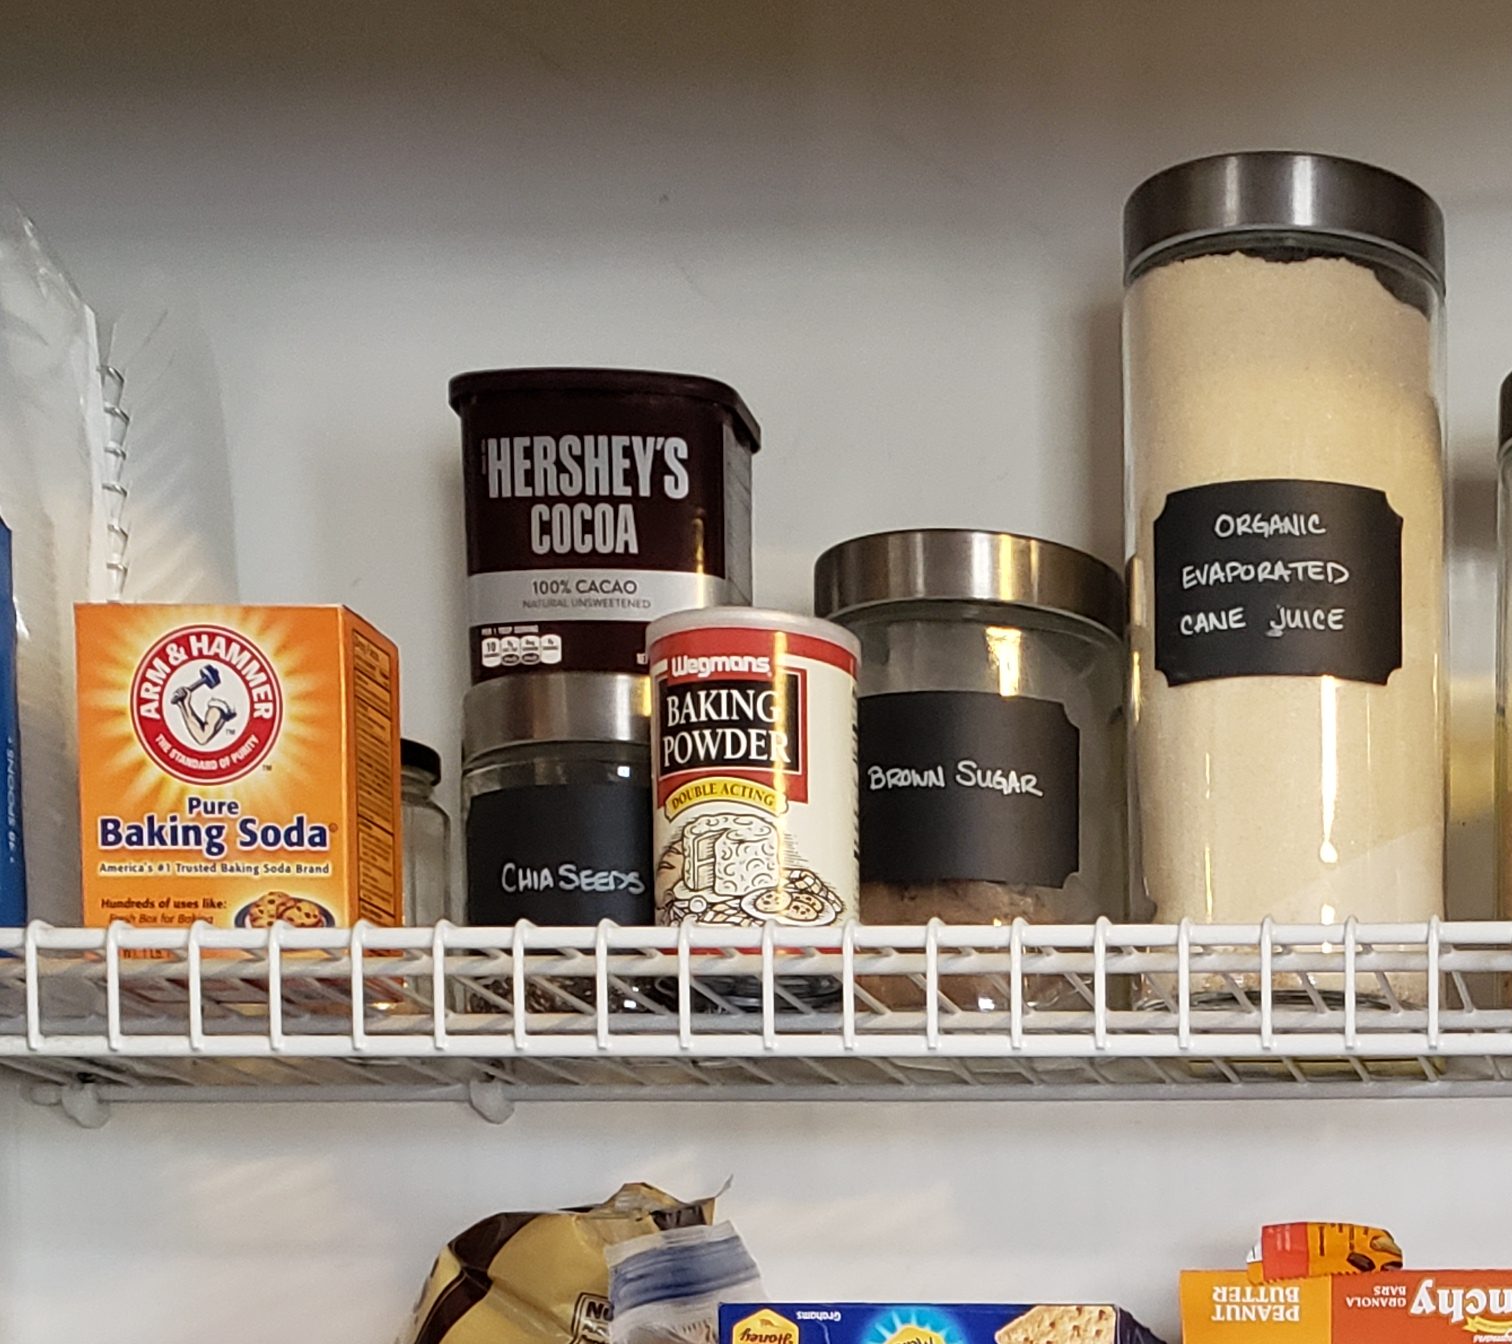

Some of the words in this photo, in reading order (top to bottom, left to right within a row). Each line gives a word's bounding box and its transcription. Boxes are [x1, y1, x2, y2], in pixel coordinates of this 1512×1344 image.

[487, 434, 690, 500] HERSHEY'S
[530, 504, 639, 555] COCOA
[1215, 513, 1326, 538] ORGANIC
[532, 580, 571, 597] 100%
[575, 579, 639, 597] CACAO
[1181, 561, 1350, 589] EVAPORATED
[1180, 607, 1247, 636] CANE
[1266, 606, 1346, 637] JUICE
[139, 662, 171, 720] ARM
[167, 641, 188, 665] &
[189, 634, 274, 719] HAMMER
[671, 655, 771, 679] Wegmans
[666, 688, 781, 727] BAKING
[662, 729, 791, 767] POWDER
[868, 764, 946, 791] BROWN
[955, 761, 1044, 798] SUGAR
[188, 797, 239, 816] Pure
[672, 783, 718, 809] DOUBLE
[720, 781, 776, 808] ACTING
[100, 817, 226, 857] Baking
[239, 816, 328, 849] Soda
[99, 862, 154, 874] America's
[157, 863, 171, 873] #1
[176, 862, 218, 874] Trusted
[221, 862, 260, 875] Baking
[264, 863, 292, 874] Soda
[295, 863, 330, 875] Brand
[502, 862, 556, 892] CHIA
[557, 864, 646, 896] SEEDS
[1211, 1286, 1300, 1303] BUTTER
[1346, 1296, 1407, 1308] GRANOLA
[1374, 1286, 1406, 1297] BARS
[796, 1310, 842, 1321] Grahams
[1211, 1304, 1300, 1322] PEANUT
